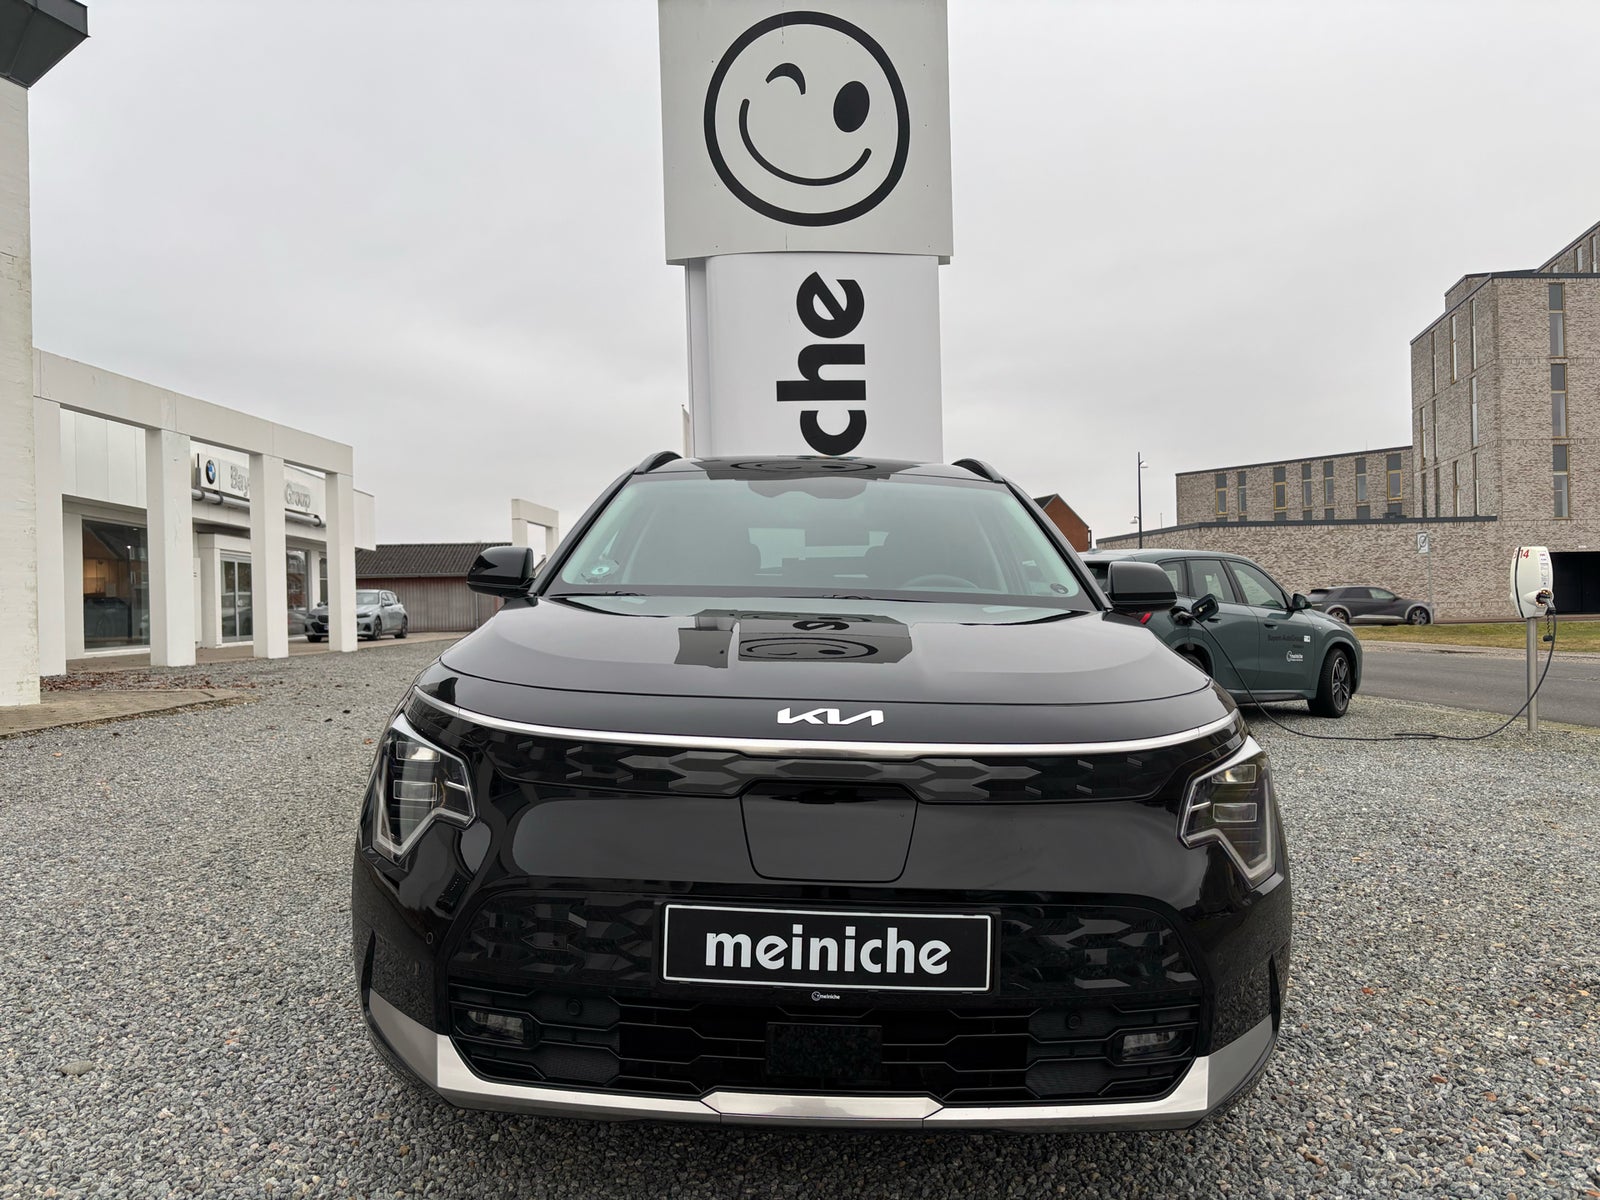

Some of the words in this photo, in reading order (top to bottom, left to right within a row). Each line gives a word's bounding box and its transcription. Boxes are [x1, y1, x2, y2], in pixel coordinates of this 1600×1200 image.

[776, 271, 867, 456] che
[777, 707, 884, 726] KIA
[705, 923, 951, 975] meiniche
